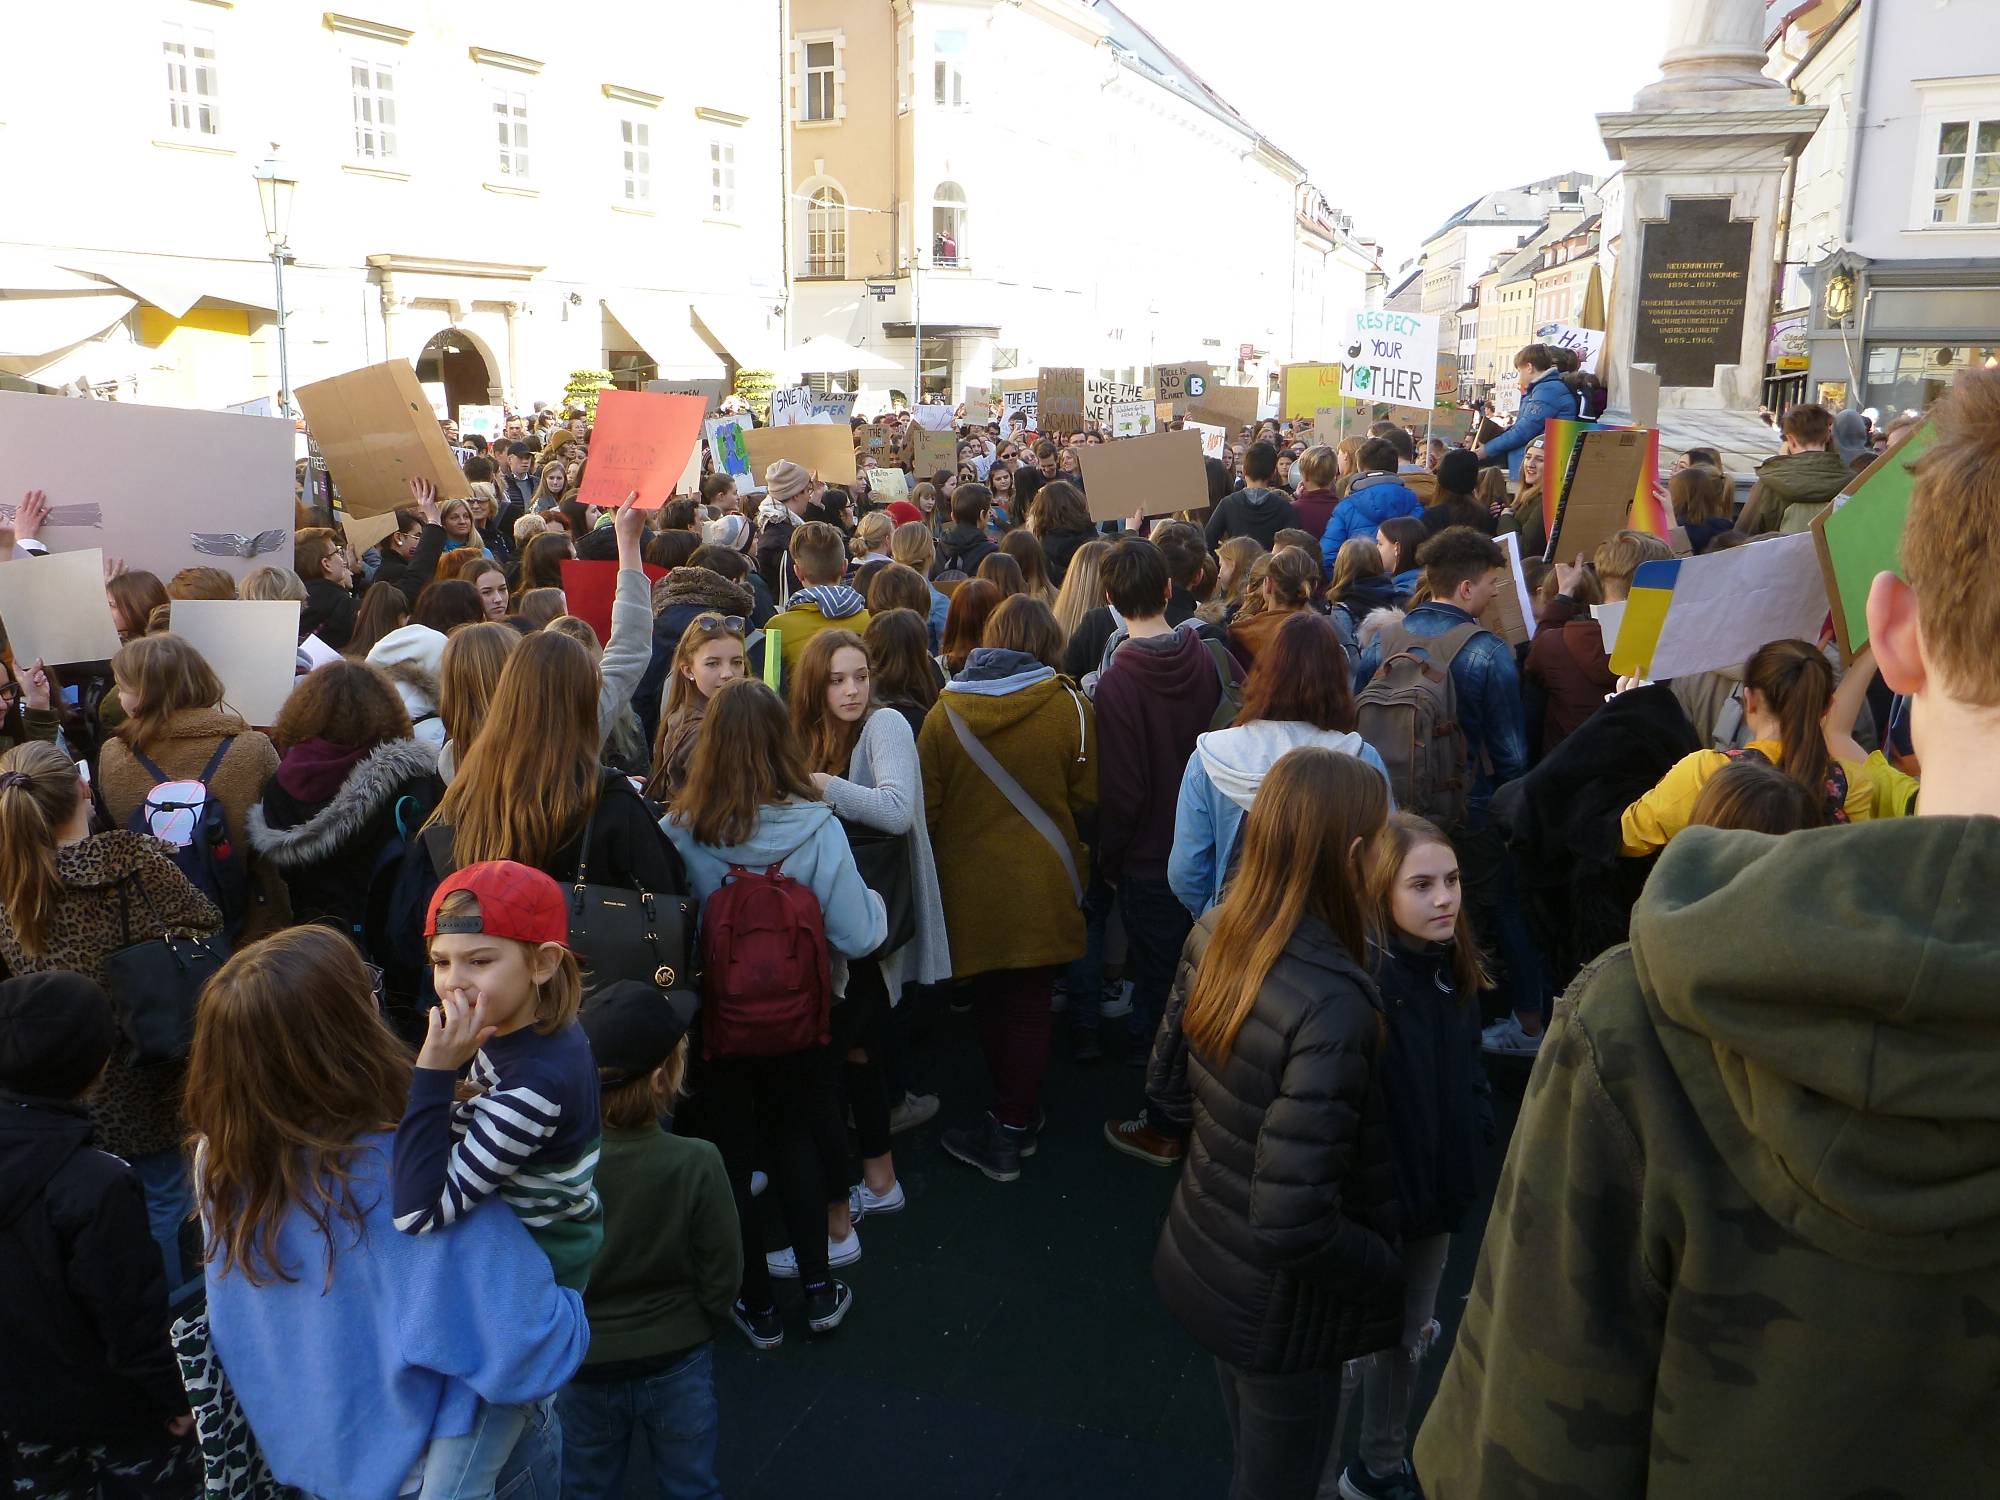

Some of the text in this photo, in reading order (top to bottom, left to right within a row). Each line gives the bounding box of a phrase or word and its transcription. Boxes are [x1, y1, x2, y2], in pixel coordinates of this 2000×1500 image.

[1356, 311, 1421, 336] RESPECT
[1371, 339, 1403, 359] YOUR
[1088, 380, 1117, 395] LIKE
[1119, 384, 1143, 398] THE
[1160, 376, 1180, 388] NO
[1191, 377, 1203, 394] B
[776, 389, 797, 413] SAVE
[1005, 393, 1022, 405] THE
[1086, 405, 1104, 420] WE
